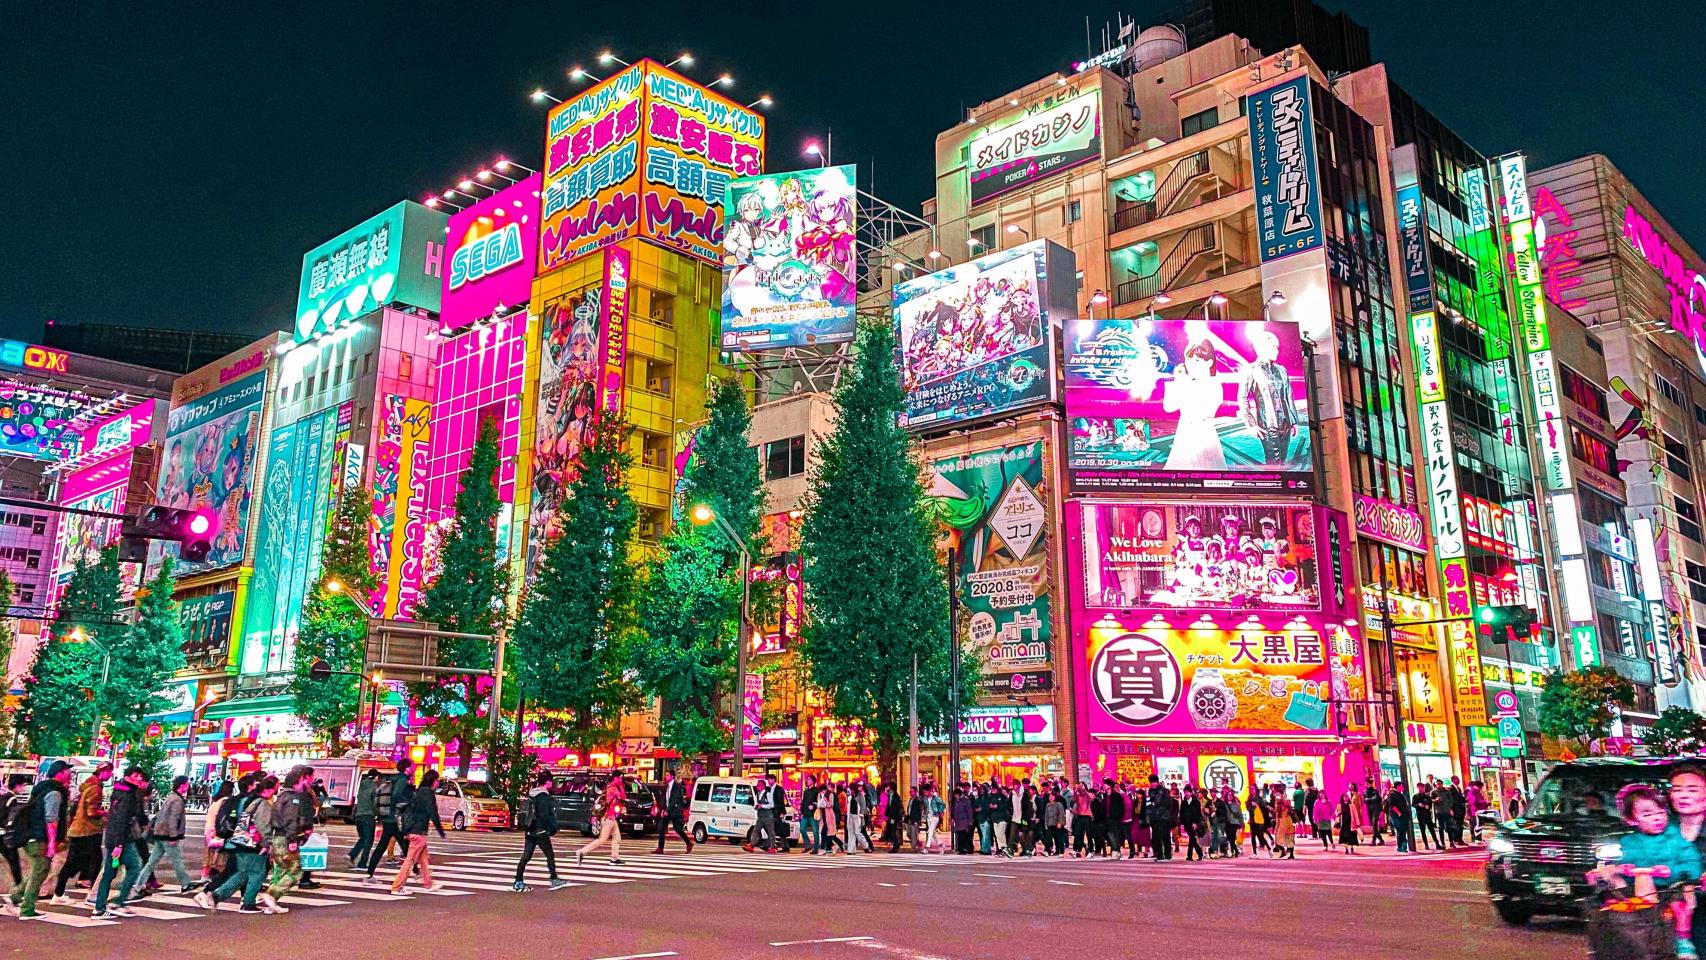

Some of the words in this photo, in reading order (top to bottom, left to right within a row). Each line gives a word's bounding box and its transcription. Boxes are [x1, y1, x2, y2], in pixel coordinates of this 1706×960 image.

[549, 98, 640, 176] 激安販売
[649, 102, 761, 177] 激安販売
[977, 105, 1091, 170] メイドカジノ
[544, 141, 637, 221] 高額買取
[1261, 194, 1276, 242] 秋葉原店
[449, 221, 524, 291] SEGA
[577, 240, 598, 257] AKIBA
[692, 244, 718, 261] AKIBA
[1522, 289, 1539, 347] Submarine
[1422, 334, 1434, 376] りらくる
[1006, 523, 1032, 540] ココ
[1355, 498, 1423, 546] メイドカジノ
[1103, 551, 1173, 562] Akihabara
[1109, 536, 1131, 548] We
[1132, 537, 1164, 548] Love
[972, 580, 1014, 596] 2020.8
[990, 593, 1034, 607] 予約受付中
[990, 642, 1045, 659] amiami
[1229, 634, 1323, 666] 大黒屋
[1464, 619, 1476, 650] TAX
[1186, 653, 1225, 665] チケット
[1467, 655, 1482, 696] FREE
[1103, 647, 1177, 715] 質
[1421, 671, 1434, 714] ルノアール
[1501, 697, 1512, 706] 40
